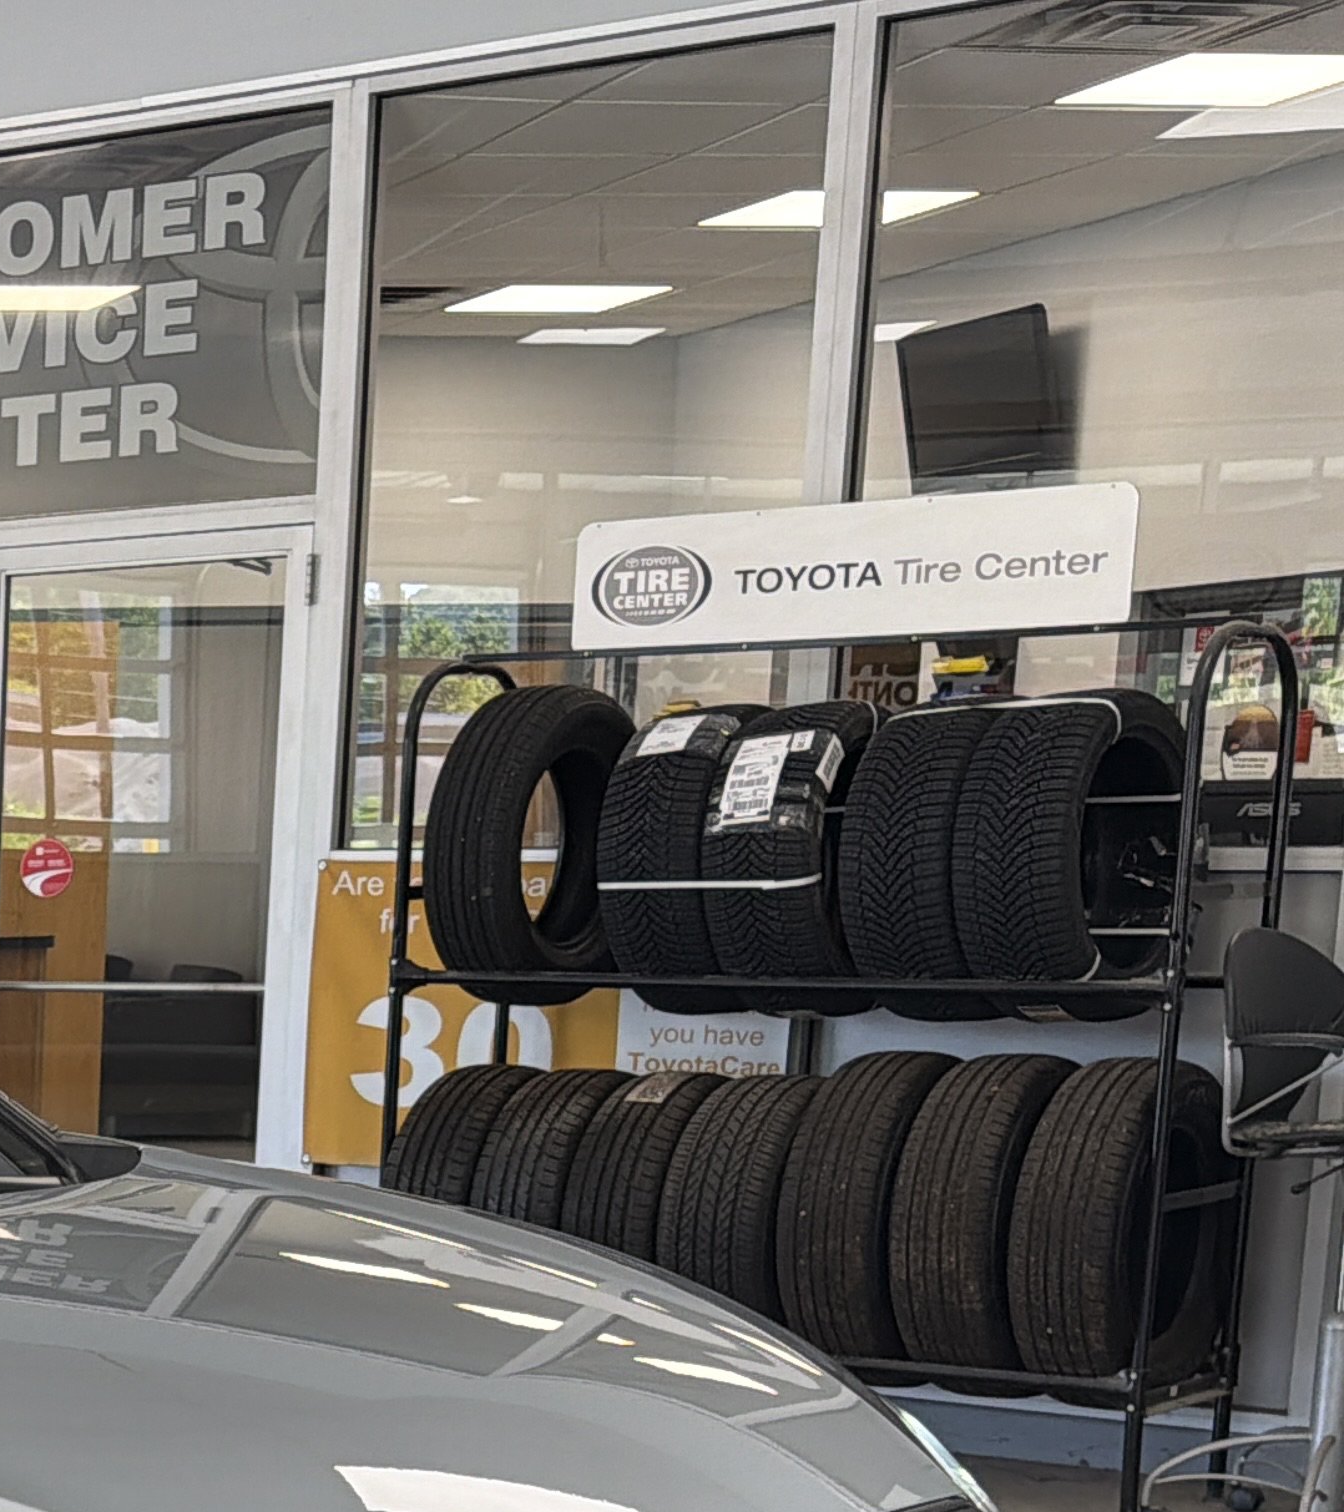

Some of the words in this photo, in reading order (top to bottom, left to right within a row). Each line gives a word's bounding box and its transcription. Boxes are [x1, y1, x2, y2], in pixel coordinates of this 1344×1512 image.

[640, 556, 680, 567] TOYOTA
[734, 562, 882, 594] TOYOTA
[894, 557, 961, 586] Tire
[975, 548, 1109, 581] Center
[613, 567, 690, 594] TIRE
[613, 593, 687, 610] CENTER
[1236, 802, 1303, 817] ASS
[332, 871, 384, 896] Are
[379, 908, 420, 935] fr
[650, 1026, 695, 1047] you
[703, 1024, 765, 1047] have
[349, 995, 553, 1107] 30
[628, 1052, 780, 1077] ToyotaCare
